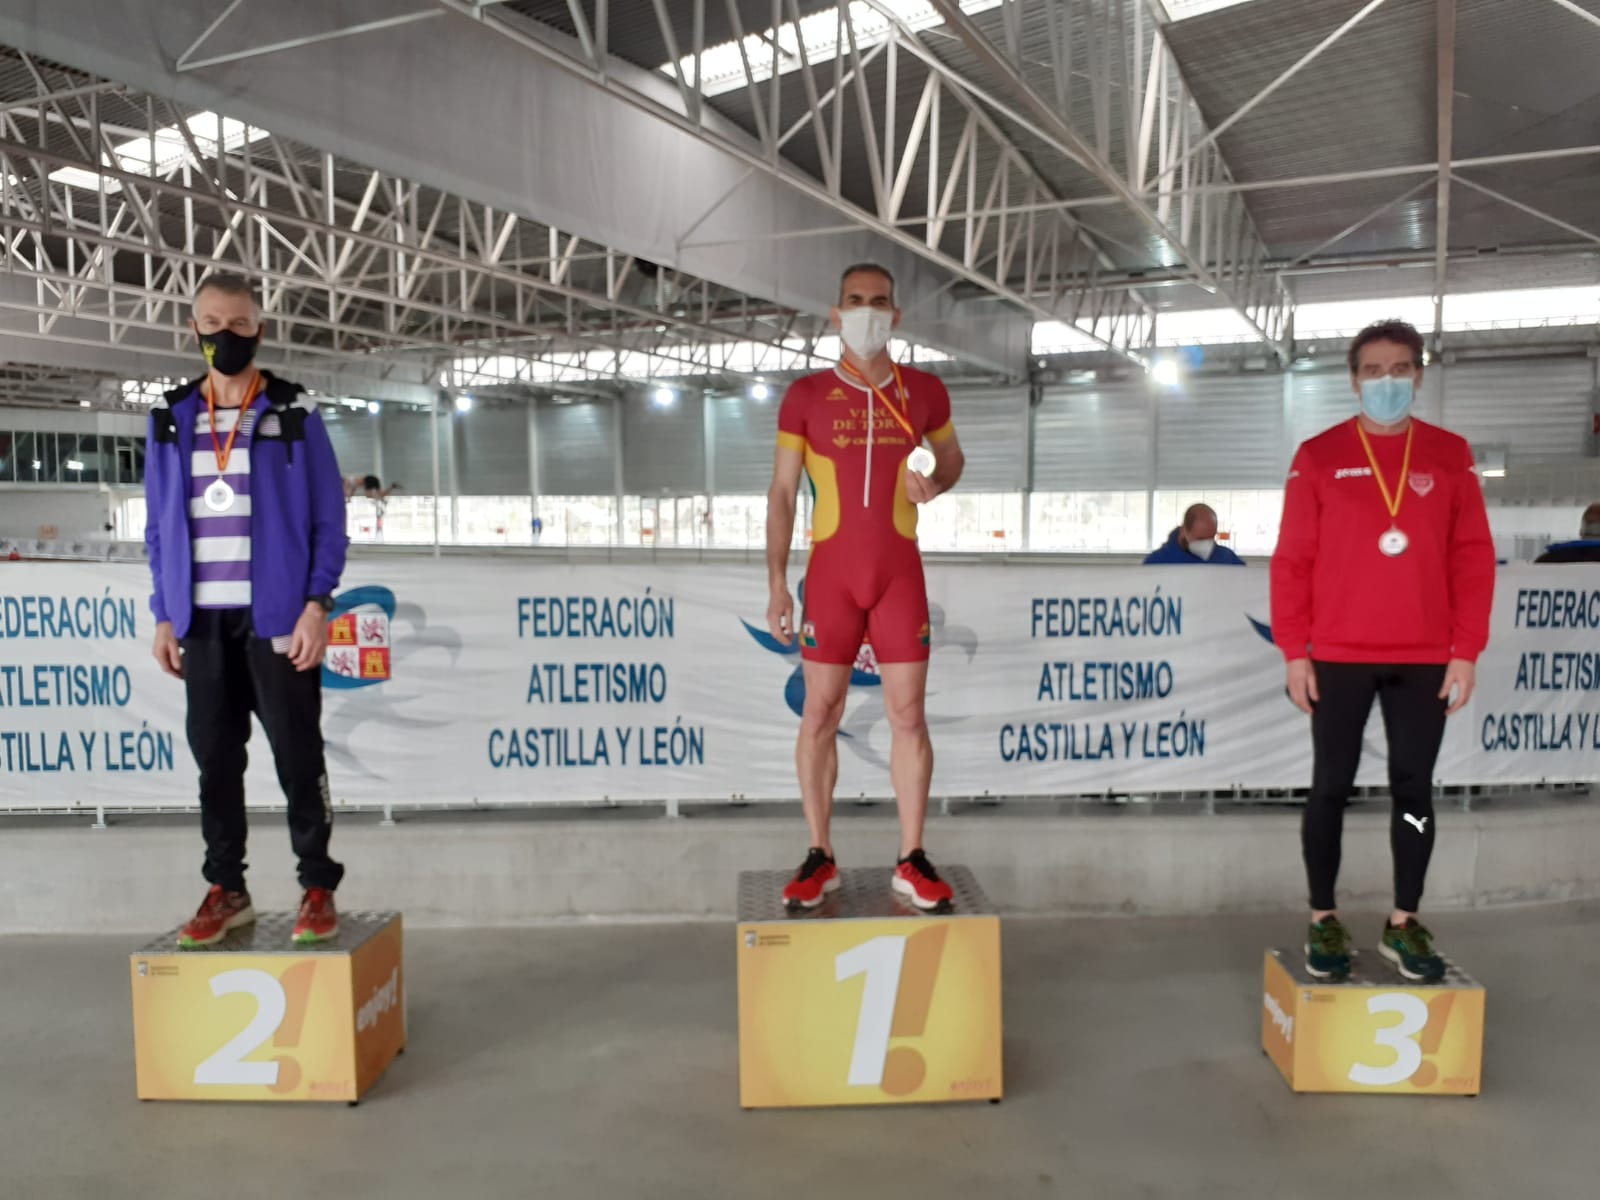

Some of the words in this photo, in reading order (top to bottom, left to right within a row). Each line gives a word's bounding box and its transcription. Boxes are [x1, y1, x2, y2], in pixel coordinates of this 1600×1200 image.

[0, 587, 136, 639] DERACIÓN
[518, 587, 673, 638] FEDERACIÓN
[1032, 586, 1181, 638] FEDERACIÓN
[0, 665, 131, 706] TLETISMO
[527, 663, 666, 703] ATLETISMO
[1037, 661, 1173, 701] ATLETISMO
[0, 731, 75, 771] TILLA
[79, 731, 96, 771] Y
[105, 720, 174, 771] LEÓN
[489, 728, 610, 768] CASTILLA
[616, 727, 631, 766] Y
[640, 716, 704, 766] LEÓN
[1000, 723, 1115, 762] CASTILLA
[1121, 722, 1137, 759] Y
[1143, 710, 1206, 758] LEÓN
[1481, 713, 1572, 751] CASTILLA
[1578, 713, 1590, 749] Y
[193, 968, 287, 1085] 2
[1348, 992, 1429, 1085] 3
